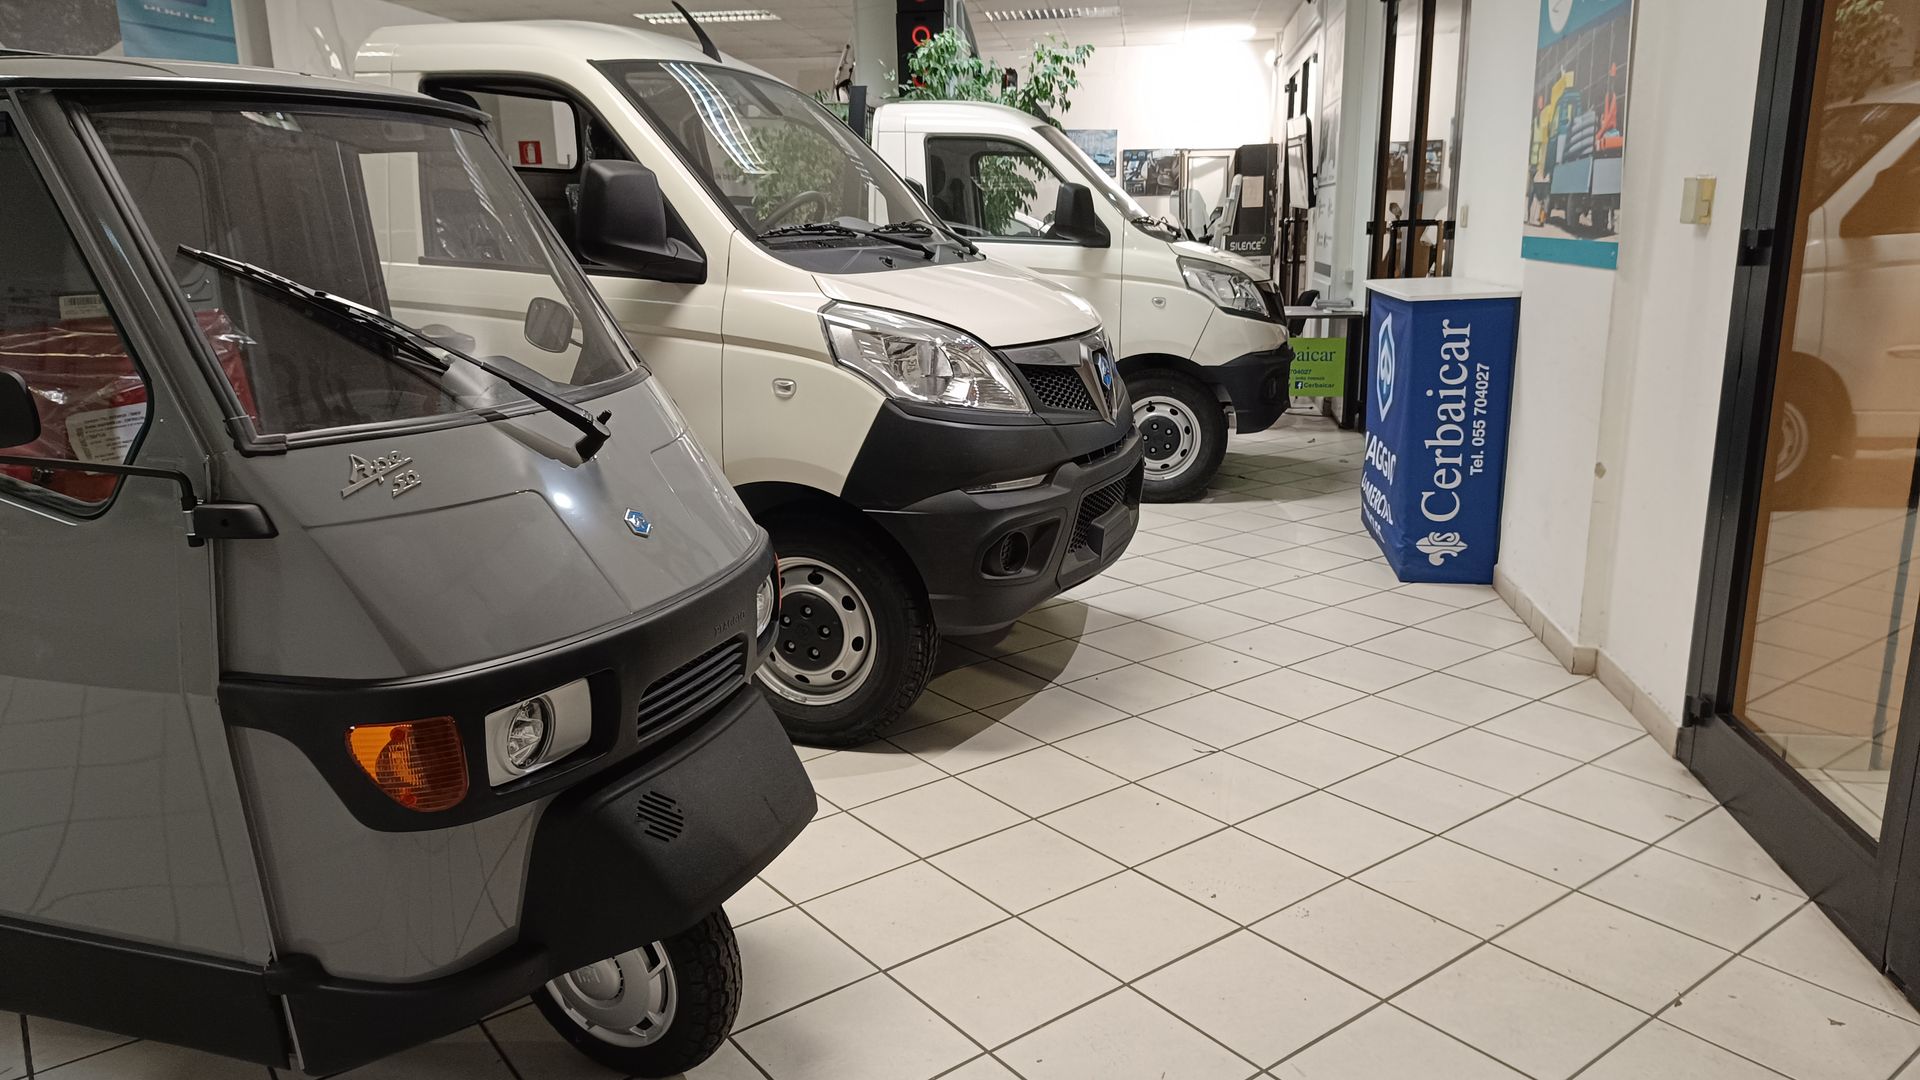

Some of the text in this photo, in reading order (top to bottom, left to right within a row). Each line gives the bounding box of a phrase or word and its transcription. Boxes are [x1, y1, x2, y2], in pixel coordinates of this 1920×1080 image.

[1229, 239, 1262, 252] SILENCE
[1420, 318, 1471, 522] Cerbaicar
[1470, 363, 1490, 476] Tel. 055 704027
